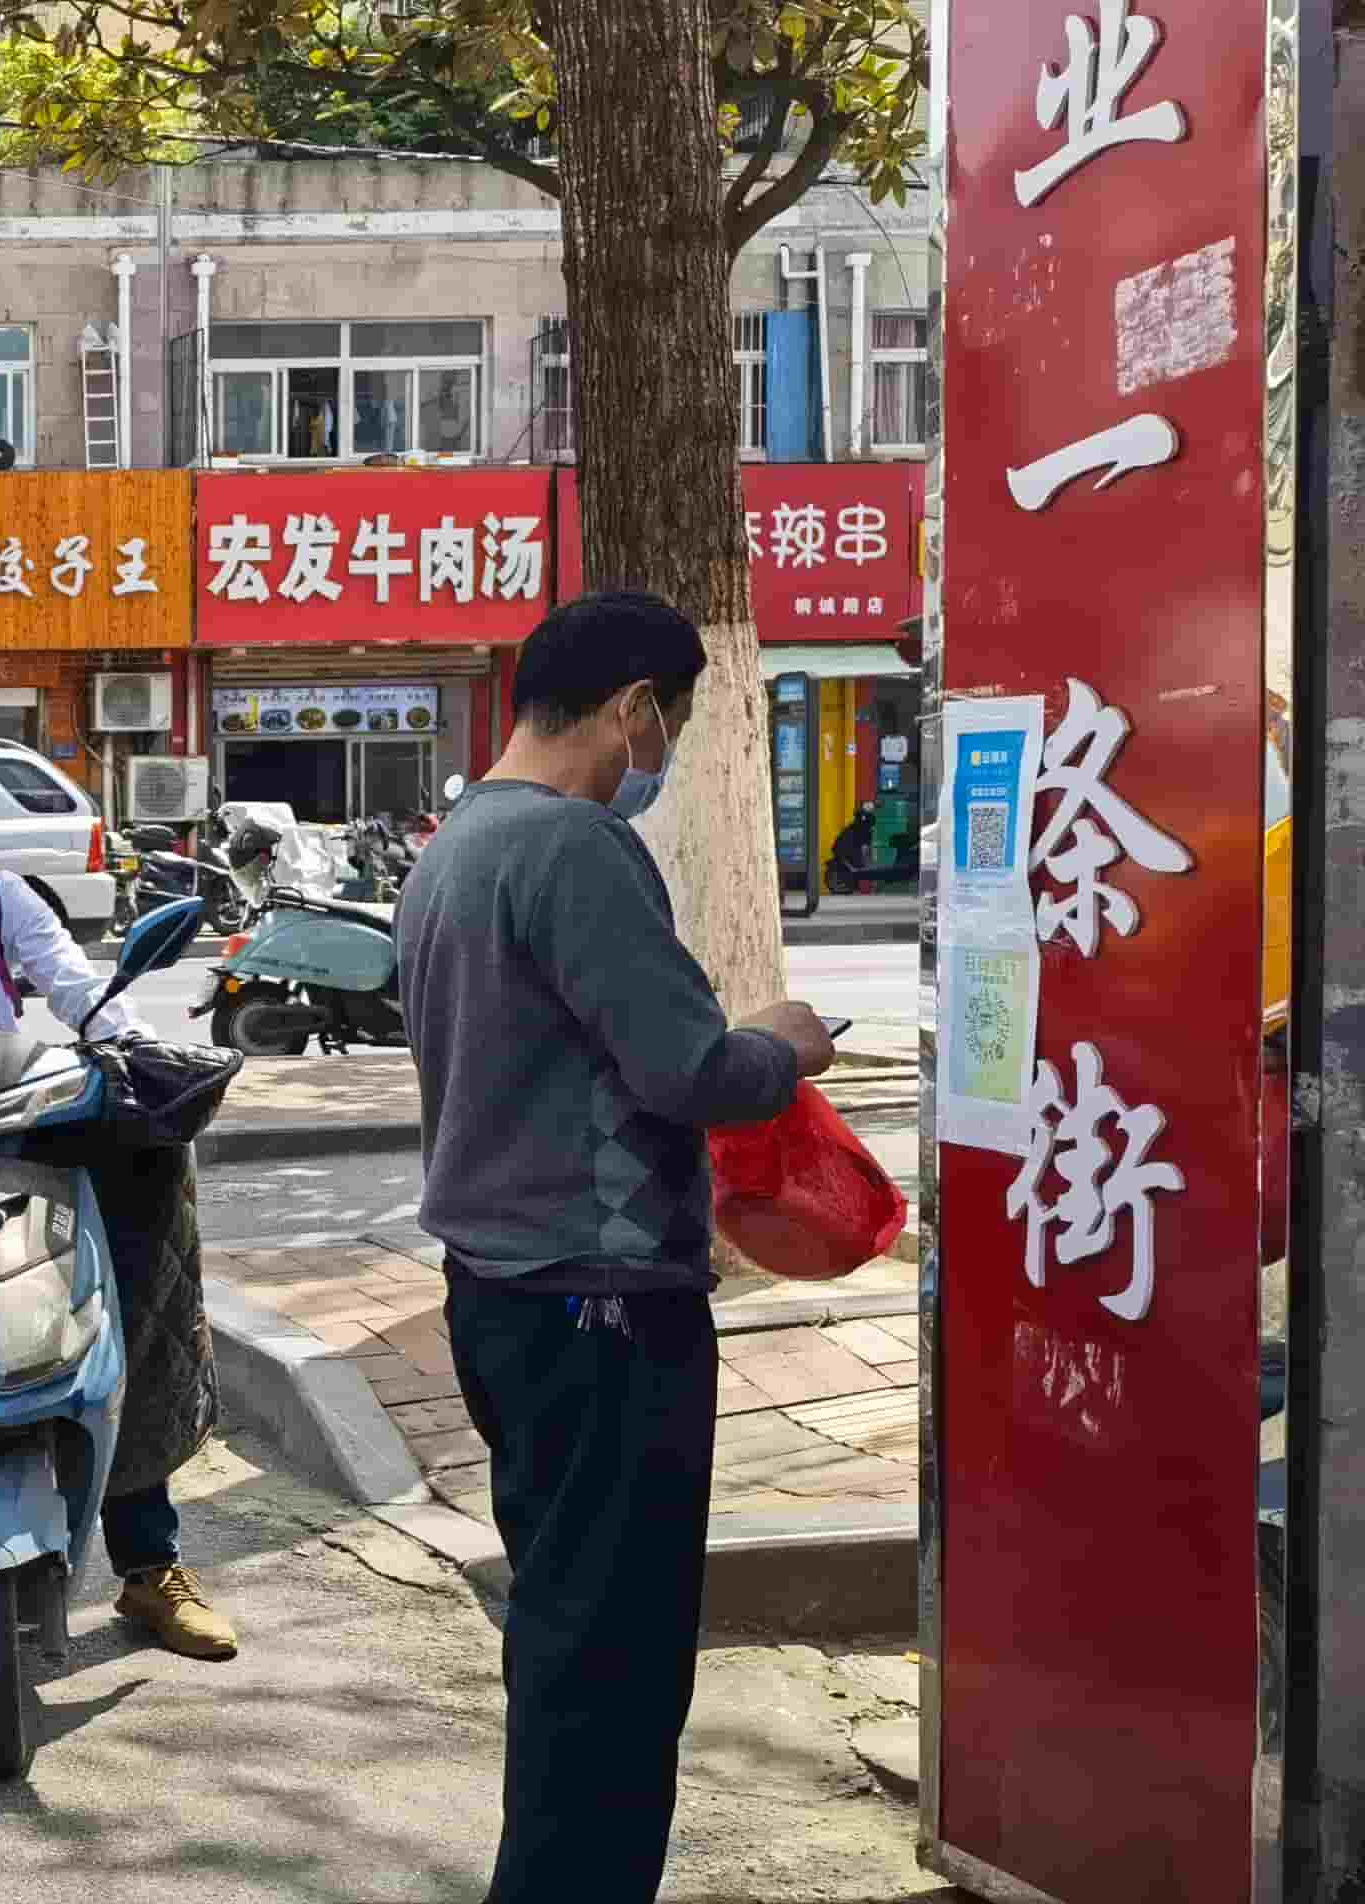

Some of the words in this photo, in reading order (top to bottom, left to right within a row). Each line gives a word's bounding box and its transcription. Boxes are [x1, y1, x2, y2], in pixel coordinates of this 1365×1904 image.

[206, 512, 543, 603] 宏发牛肉汤
